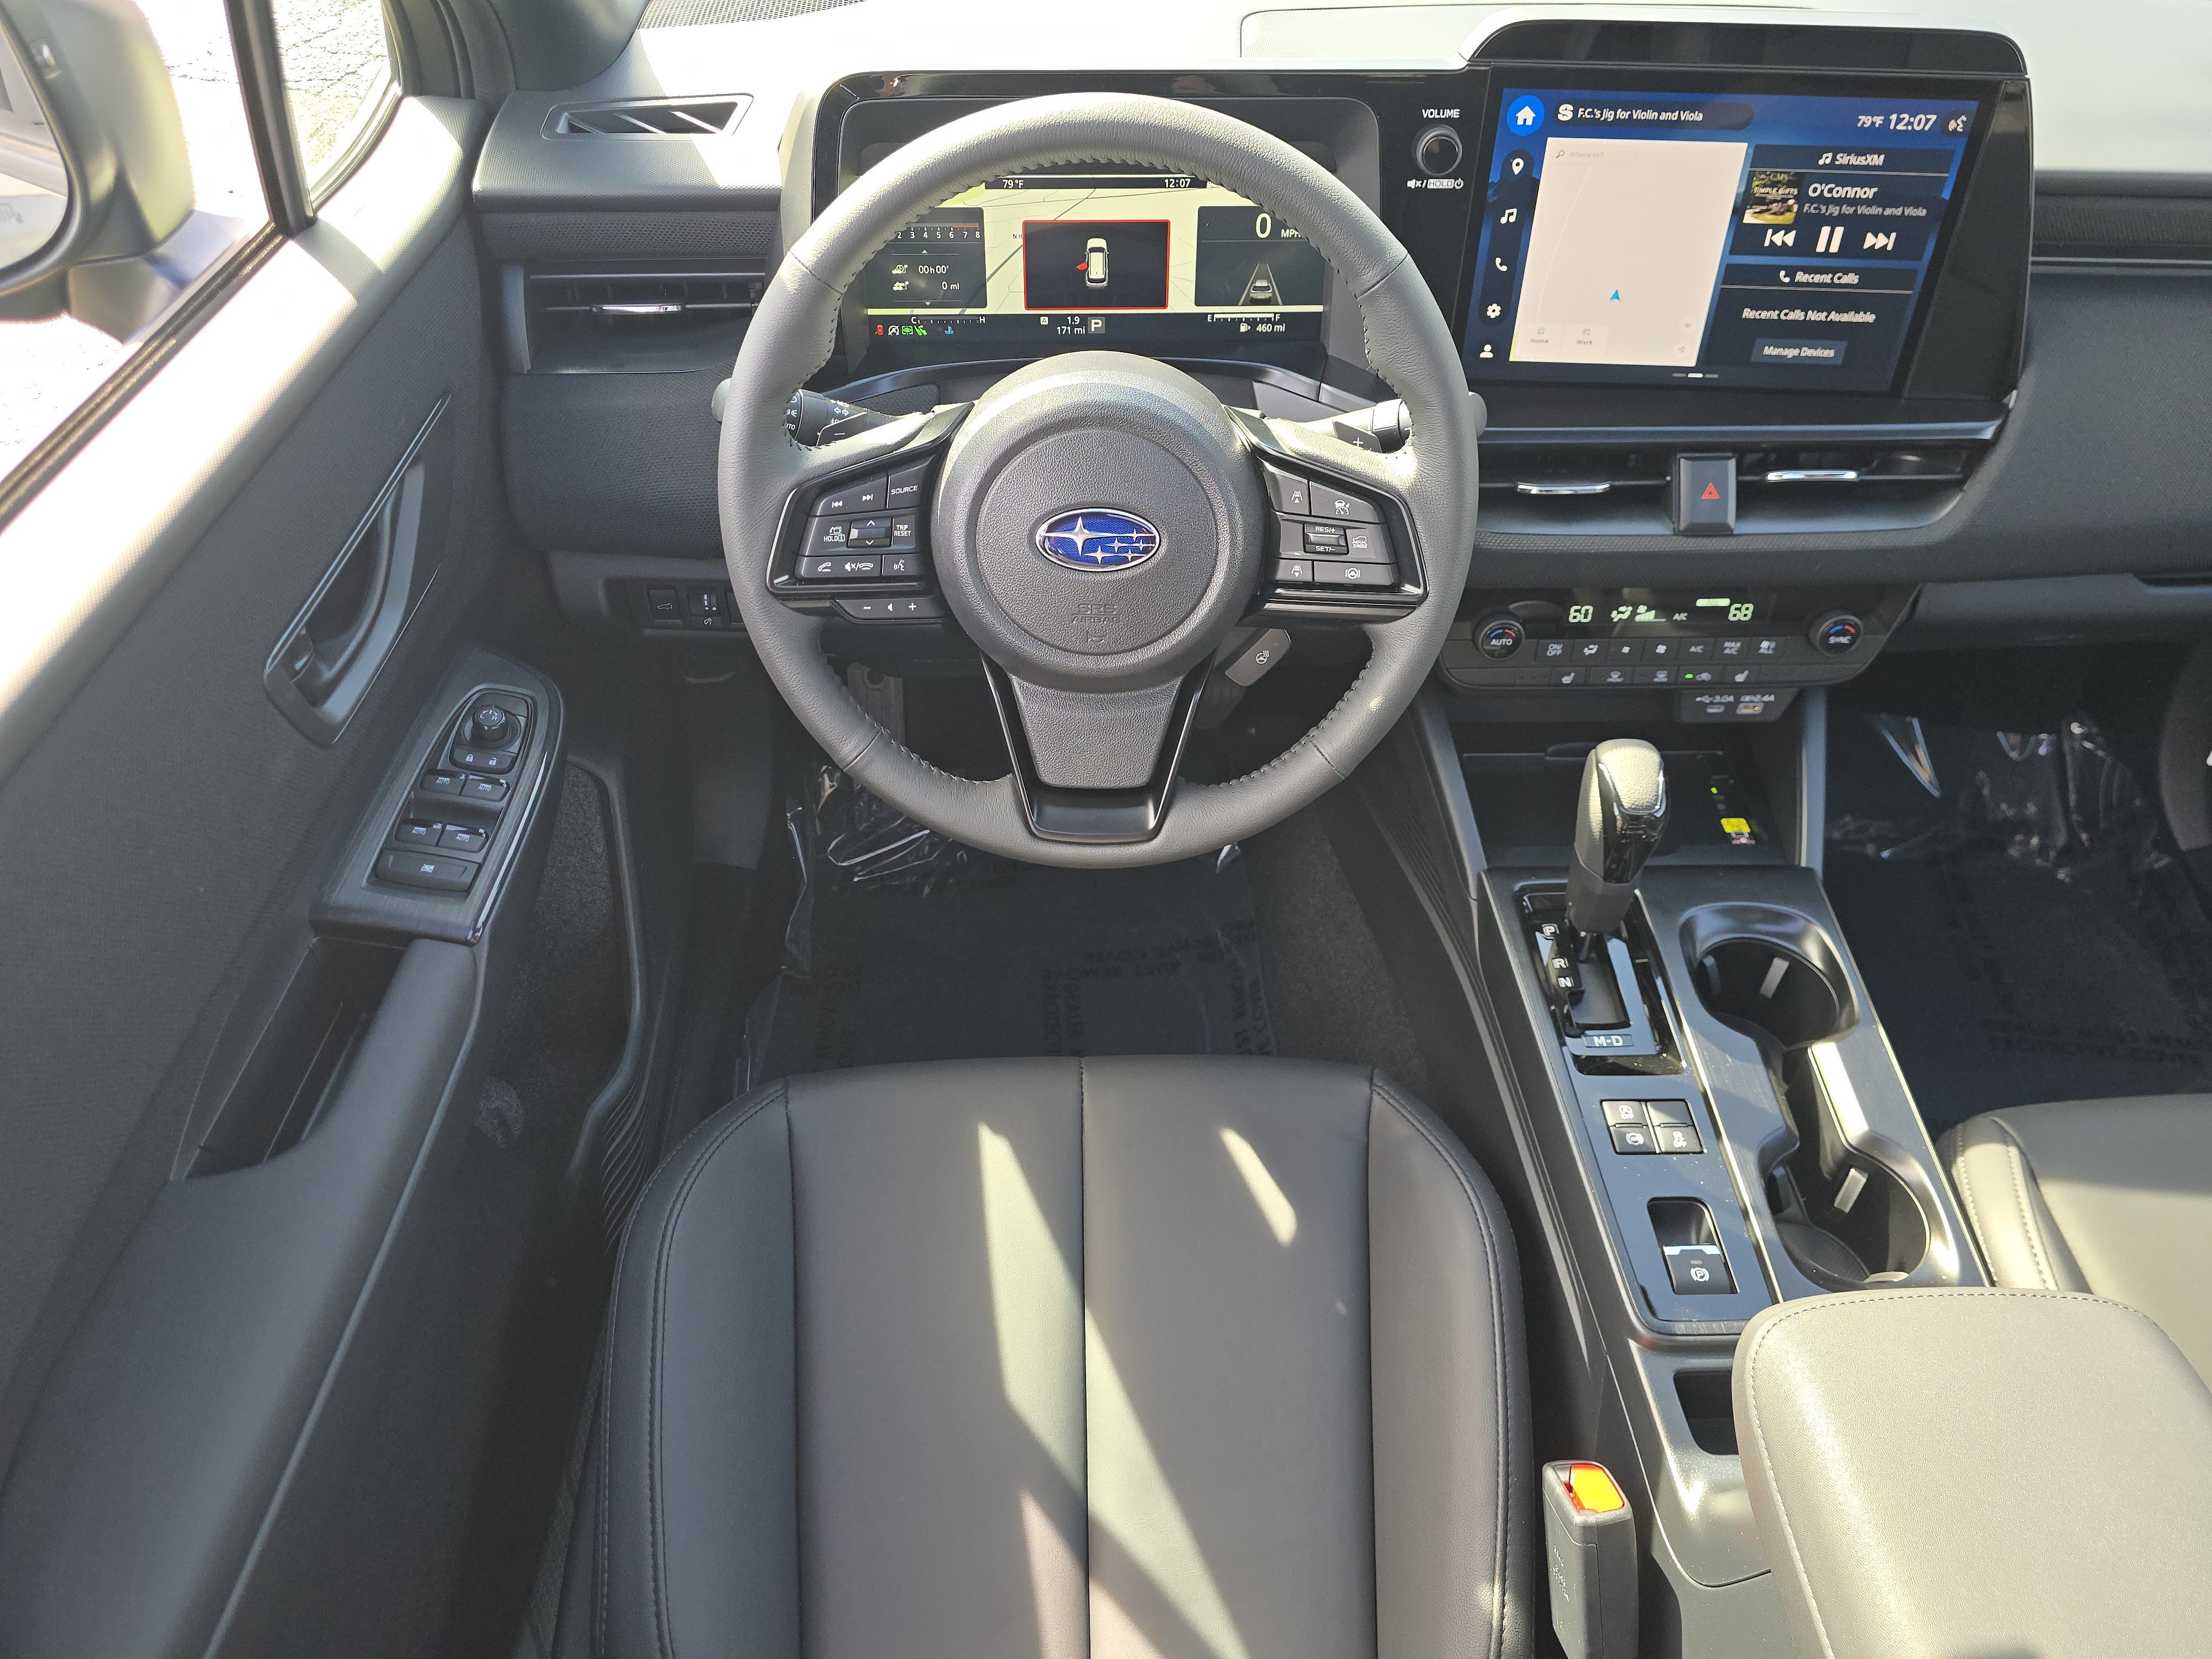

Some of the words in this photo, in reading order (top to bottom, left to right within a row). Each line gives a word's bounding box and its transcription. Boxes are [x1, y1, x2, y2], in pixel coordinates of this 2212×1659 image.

[1422, 108, 1460, 118] VOLUME
[1600, 108, 1614, 121] Jig
[1616, 109, 1631, 119] for
[1632, 109, 1658, 121] Violin
[1659, 110, 1679, 121] and
[1680, 110, 1703, 121] Viola
[1857, 115, 1885, 128] 79°F
[1889, 113, 1937, 131] 12:07
[1835, 153, 1885, 166] SiriusXM
[1165, 178, 1191, 188] 12:07
[1808, 183, 1879, 199] O'Connor
[1825, 204, 1840, 216] Jig
[1841, 204, 1856, 215] for
[1857, 205, 1883, 216] Violin
[1883, 206, 1903, 216] and
[1903, 206, 1927, 217] Viola
[1256, 213, 1271, 238] 0
[1794, 271, 1833, 283] Recent
[1833, 273, 1860, 284] Calls
[942, 281, 948, 290] 0
[950, 282, 960, 290] mi
[1067, 316, 1080, 325] 1.9
[1742, 307, 1780, 319] Recent
[1780, 309, 1806, 321] Calls
[1806, 310, 1828, 321] Not
[1827, 311, 1876, 323] Available
[1057, 326, 1071, 335] 171
[1074, 326, 1085, 335] mi
[1091, 319, 1102, 332] P
[1256, 324, 1272, 332] 460
[1274, 323, 1286, 332] mi
[1763, 346, 1799, 358] Manage
[1800, 347, 1835, 357] Devices
[890, 484, 919, 495] SOURCE
[1568, 605, 1594, 623] 60
[1728, 603, 1754, 621] 68
[1545, 925, 1556, 936] P
[1553, 958, 1567, 968] R
[1558, 977, 1573, 987] N
[1592, 1035, 1624, 1046] M-D
